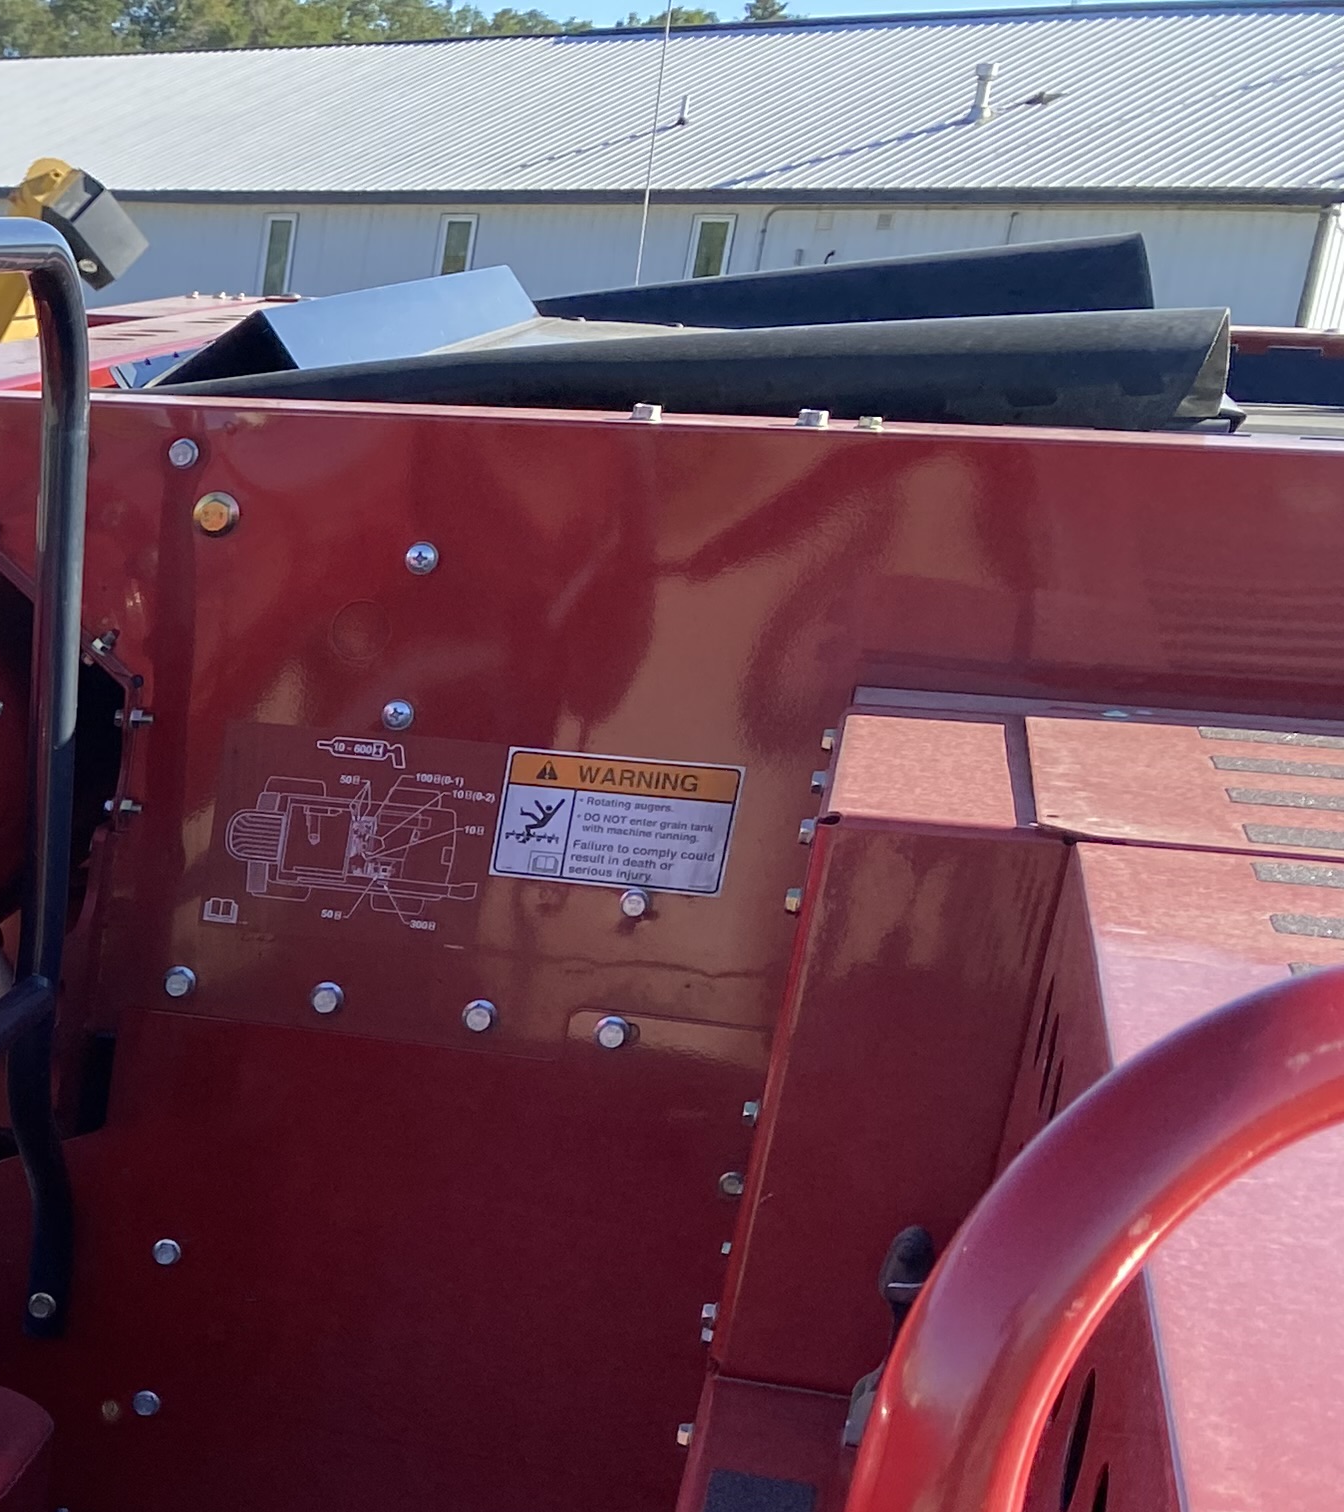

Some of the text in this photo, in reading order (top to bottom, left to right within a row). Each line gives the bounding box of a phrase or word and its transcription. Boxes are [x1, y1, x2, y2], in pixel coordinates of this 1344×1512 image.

[334, 742, 345, 752] 10
[354, 744, 372, 754] 600
[340, 775, 351, 785] 50
[415, 772, 433, 782] 100
[578, 765, 699, 792] WARNING
[452, 789, 464, 799] 10
[587, 796, 674, 814] Rotating augers.
[464, 825, 476, 835] 10
[584, 813, 713, 833] DO NOT enter grain tank
[582, 824, 699, 843] with machine running.
[573, 839, 715, 862] Failure to comply could
[570, 852, 674, 871] result in death or
[568, 864, 653, 882] serious injury.
[321, 908, 333, 919] 50
